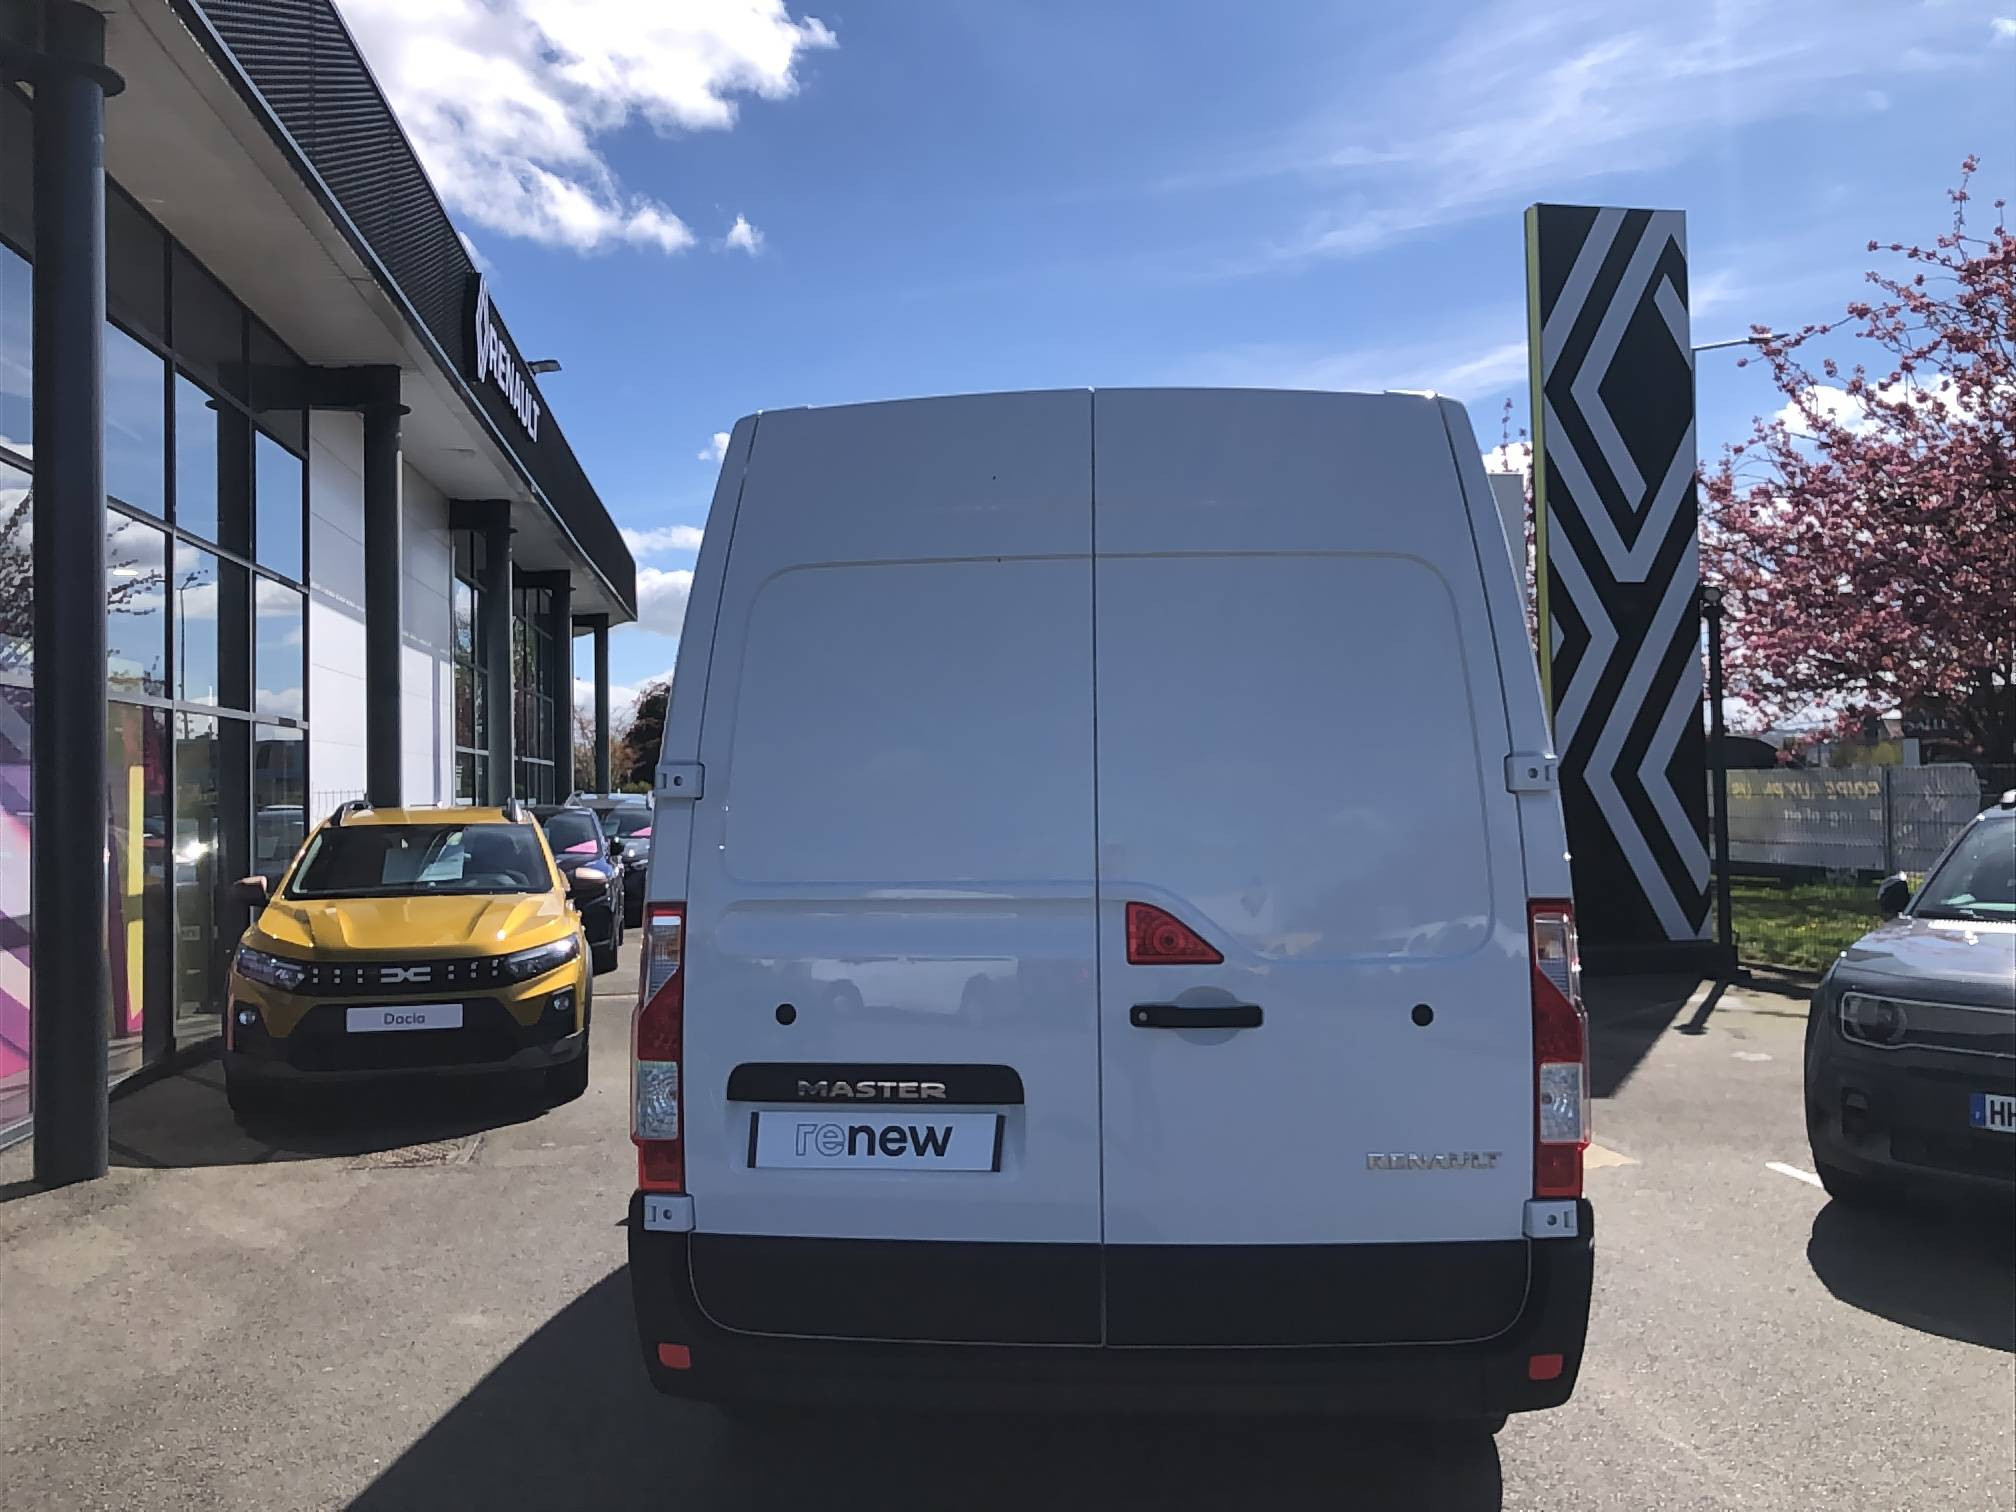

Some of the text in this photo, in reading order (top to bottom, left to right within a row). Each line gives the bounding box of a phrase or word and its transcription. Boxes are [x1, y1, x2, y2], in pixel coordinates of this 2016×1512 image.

[489, 323, 540, 443] RENAULT
[384, 1012, 426, 1025] Dacia
[797, 1080, 948, 1099] MASTER
[795, 1123, 953, 1158] renew
[1366, 1152, 1502, 1170] RENAULT
